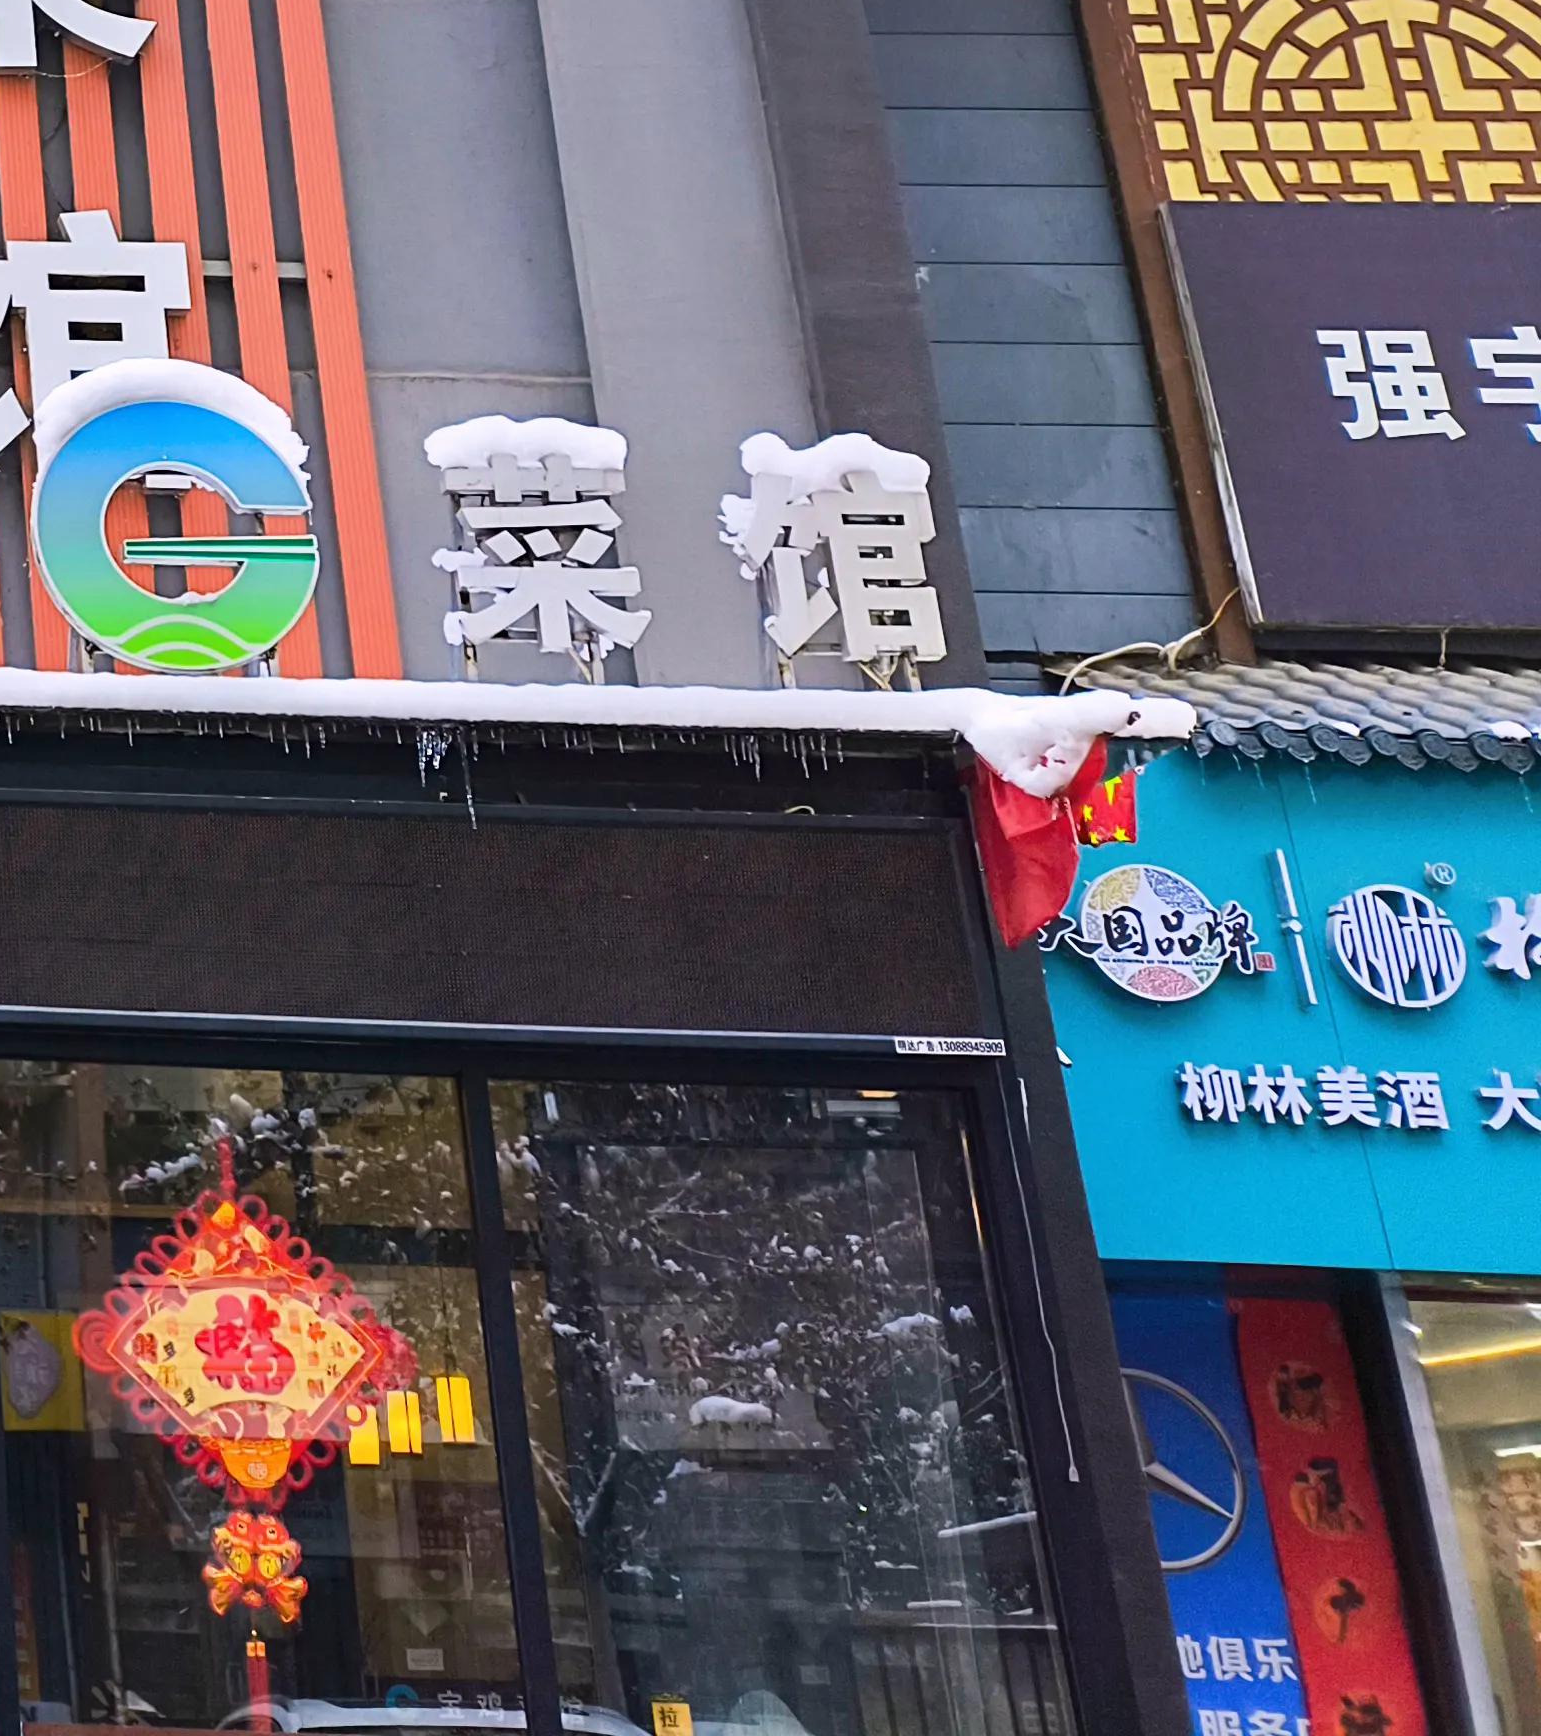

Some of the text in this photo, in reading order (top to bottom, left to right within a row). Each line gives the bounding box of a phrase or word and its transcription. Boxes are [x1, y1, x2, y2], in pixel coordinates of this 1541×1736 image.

[938, 1040, 1003, 1053] 13088945909
[1182, 1062, 1449, 1130] 柳林美酒
[658, 1706, 679, 1727] 拉
